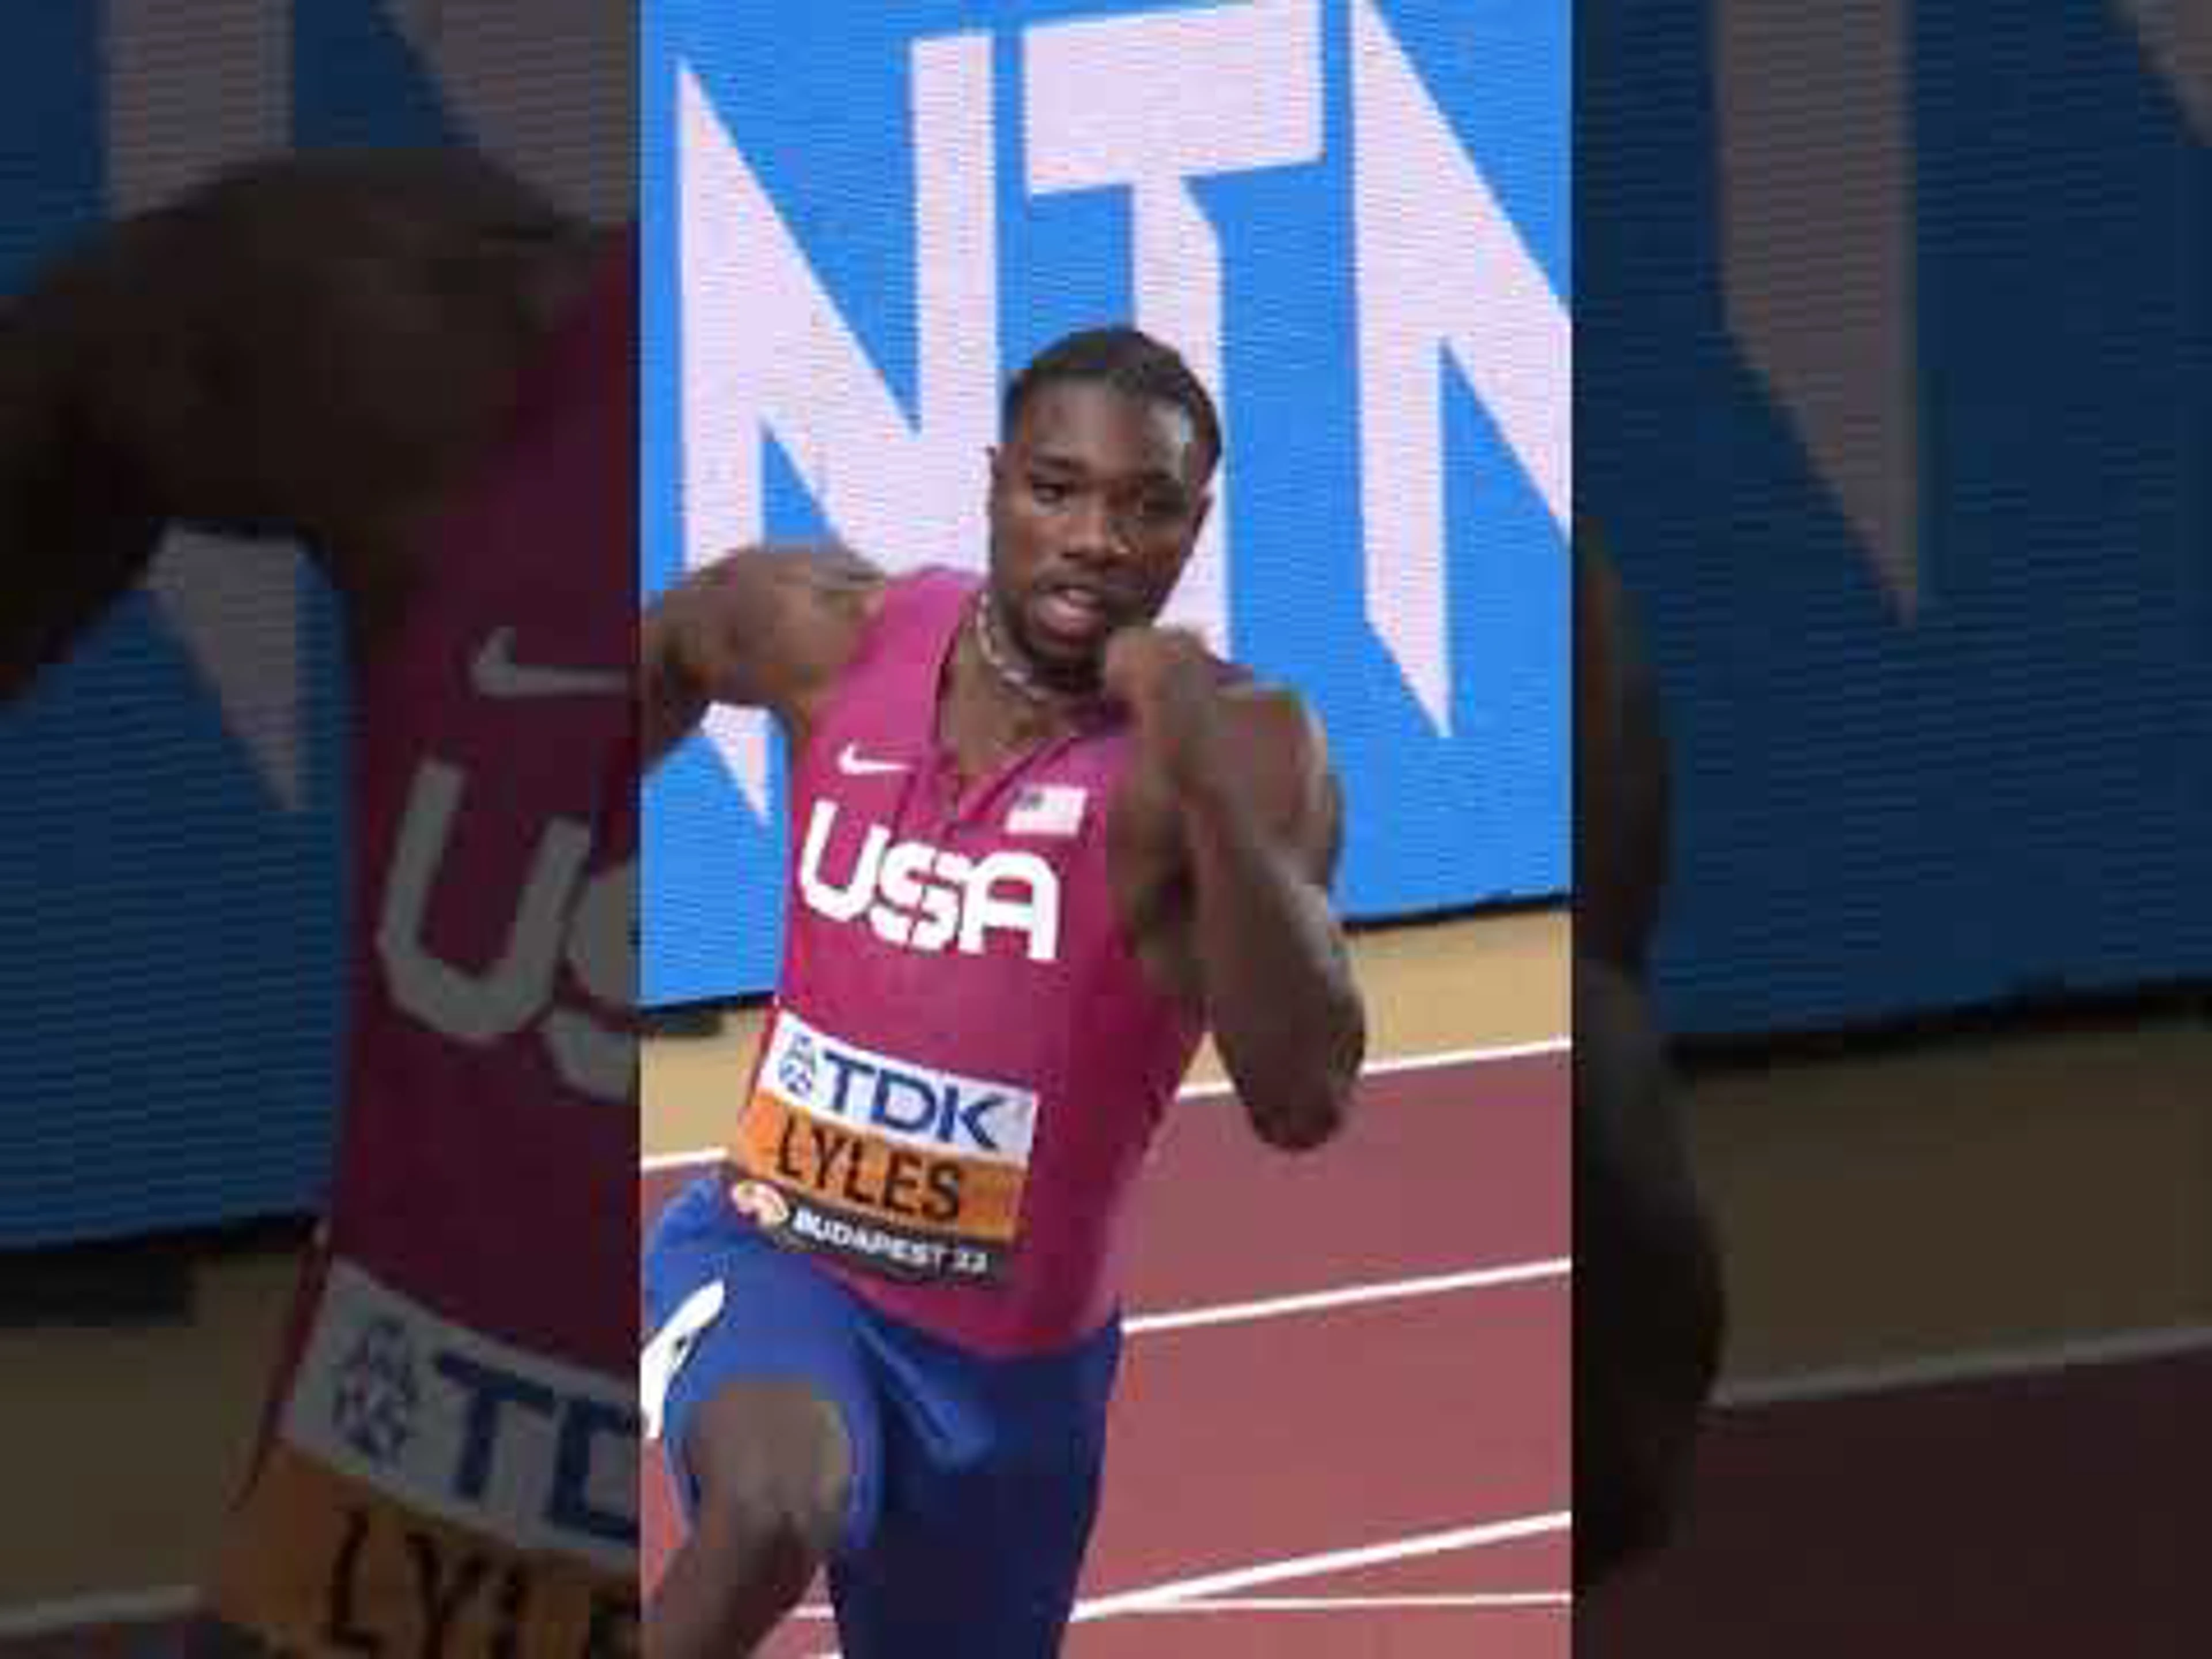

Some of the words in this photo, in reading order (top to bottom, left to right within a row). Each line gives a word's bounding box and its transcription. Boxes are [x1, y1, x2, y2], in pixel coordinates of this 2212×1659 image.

[799, 800, 1059, 961] USA
[823, 1050, 1009, 1149] TDK
[775, 1113, 960, 1222] LYLES
[793, 1207, 945, 1268] BUDAPEST
